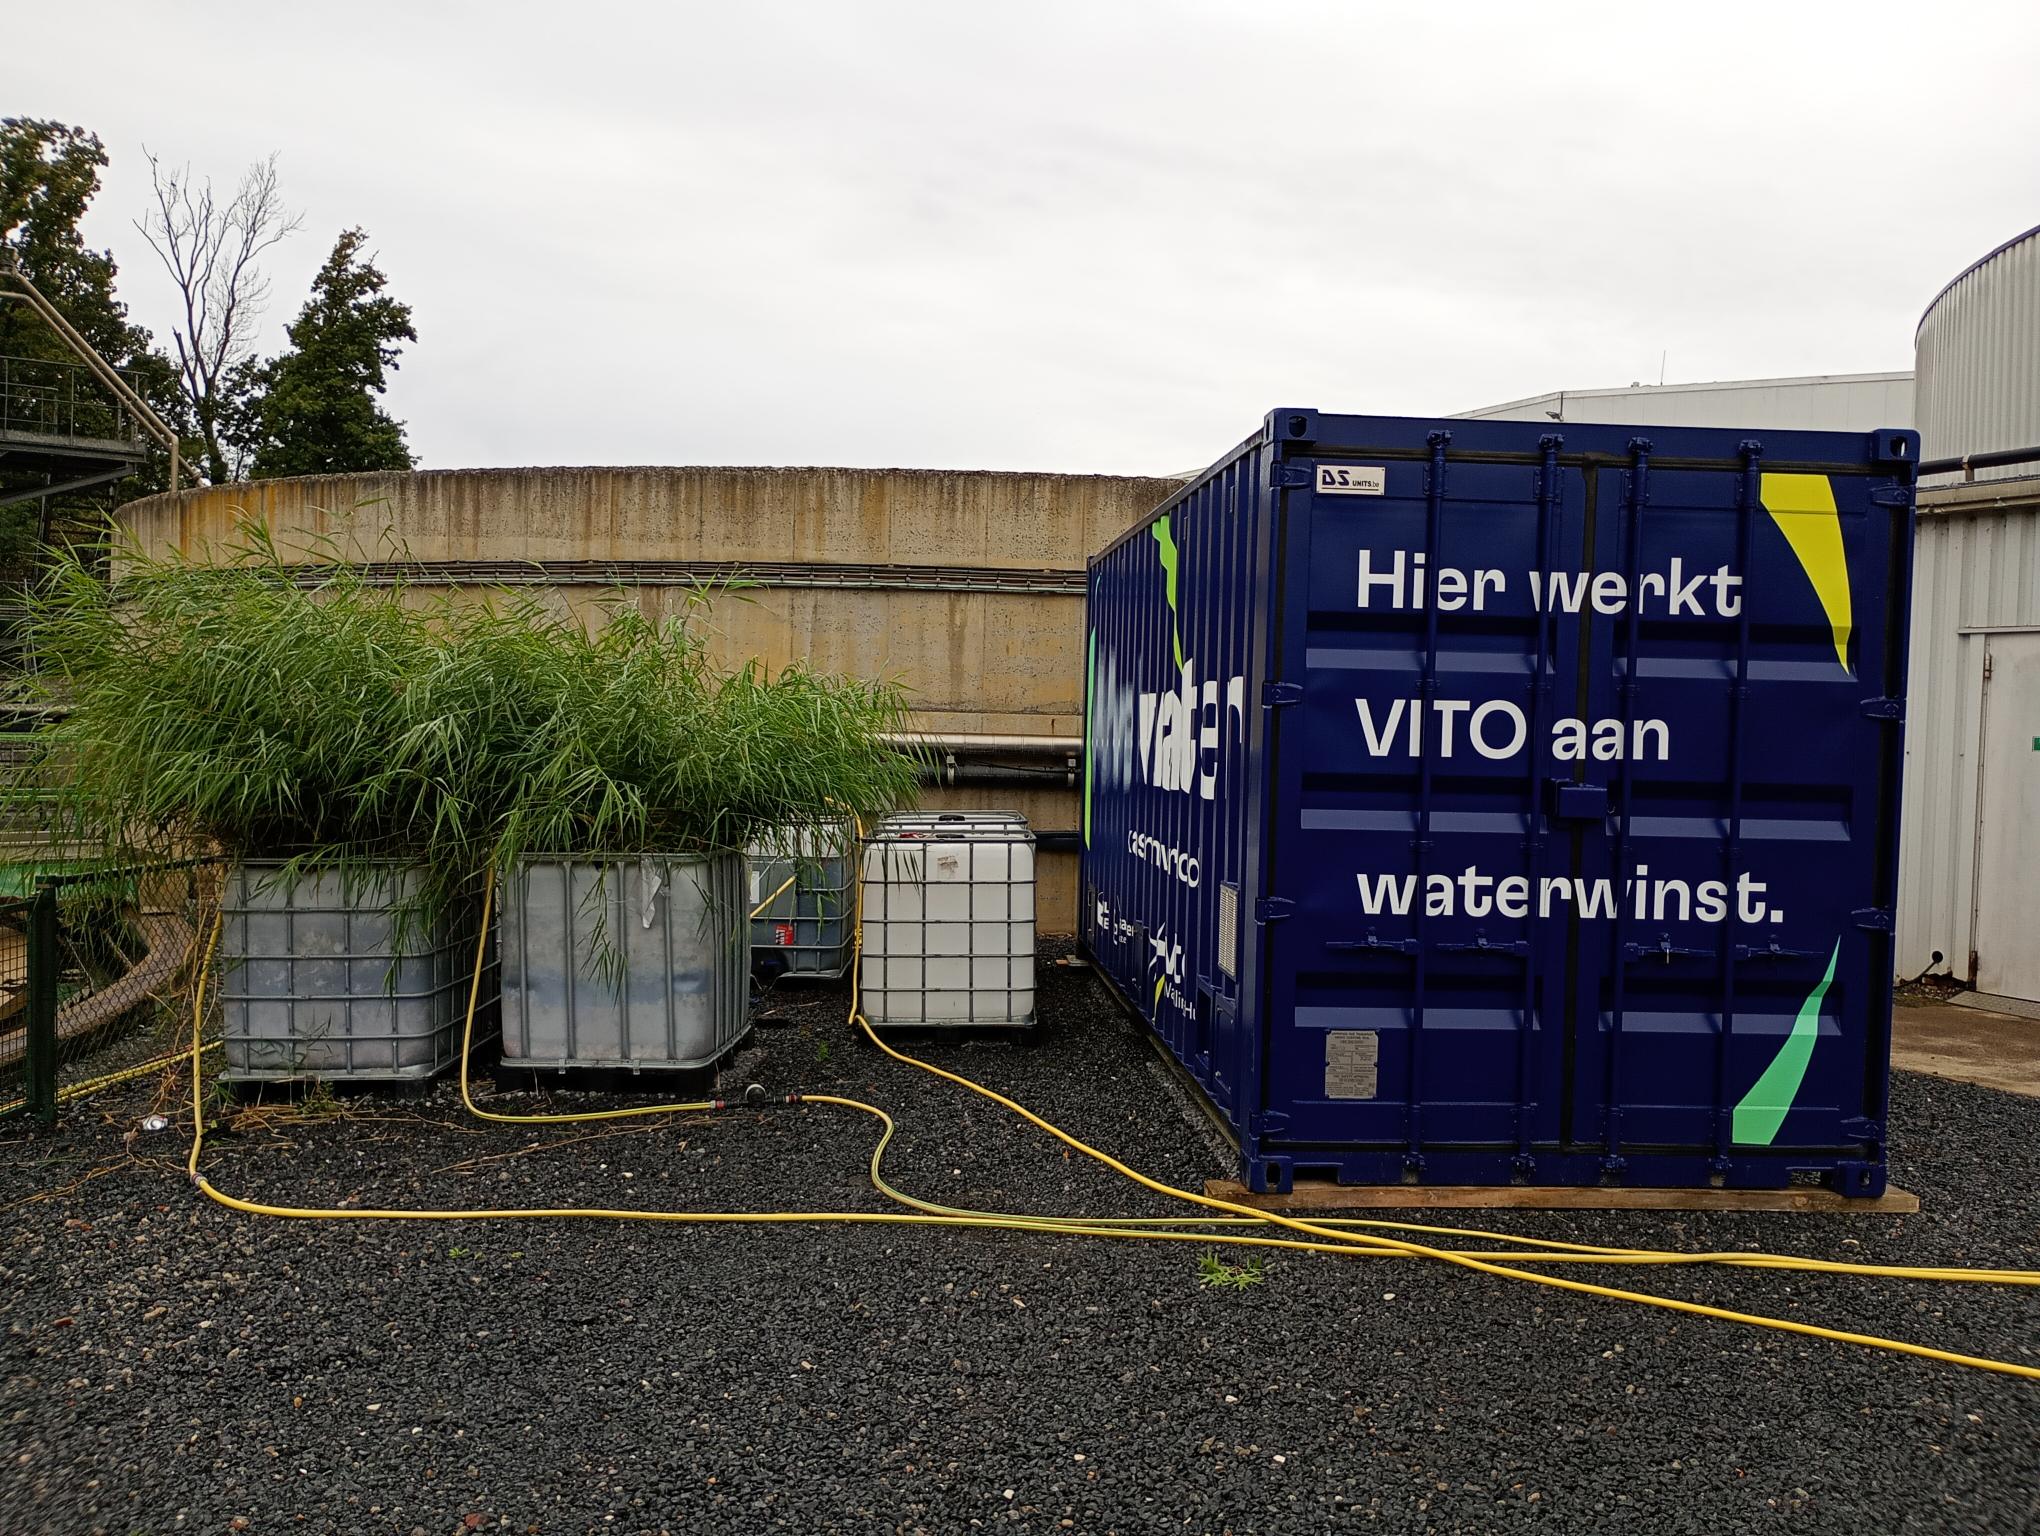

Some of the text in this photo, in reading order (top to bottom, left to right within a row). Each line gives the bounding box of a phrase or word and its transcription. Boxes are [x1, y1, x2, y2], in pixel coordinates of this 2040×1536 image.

[1322, 469, 1350, 487] DS
[1357, 549, 1743, 617] Hier werkt
[1355, 698, 1669, 761] VITO aan
[1356, 864, 1784, 924] waterwinst.
